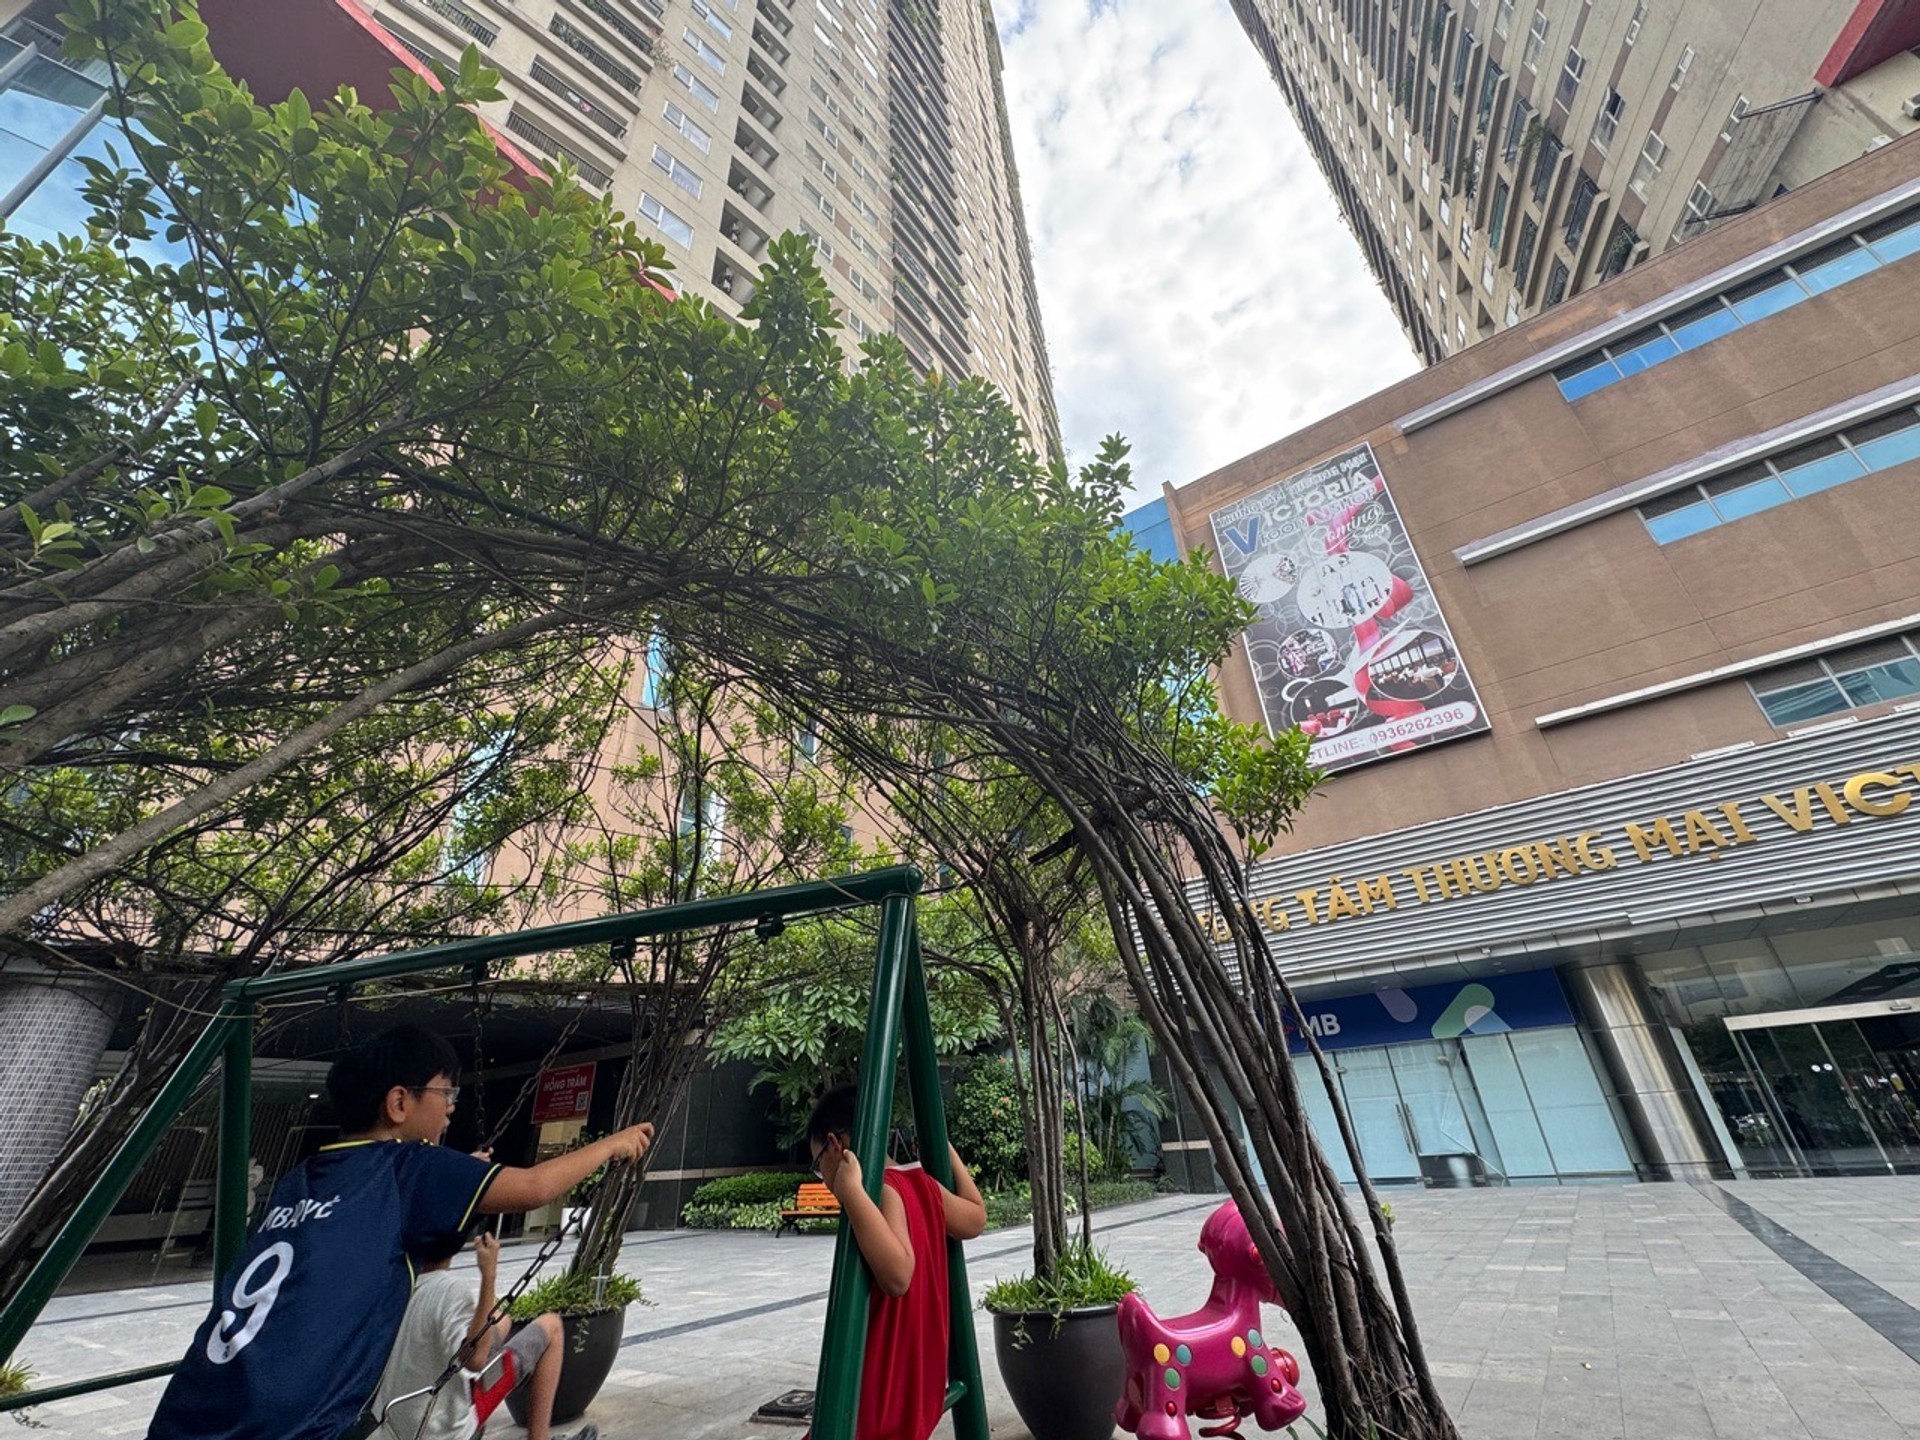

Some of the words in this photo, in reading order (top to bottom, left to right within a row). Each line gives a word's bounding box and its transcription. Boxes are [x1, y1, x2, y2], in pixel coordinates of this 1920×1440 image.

[1223, 470, 1373, 556] VICTORIA
[1309, 737, 1366, 763] TLINE:
[1369, 707, 1464, 744] 0936262396
[1296, 875, 1398, 926] TÂM
[1402, 830, 1617, 904] THƯƠNG
[1624, 801, 1757, 862] MẠI
[206, 1241, 294, 1364] 9
